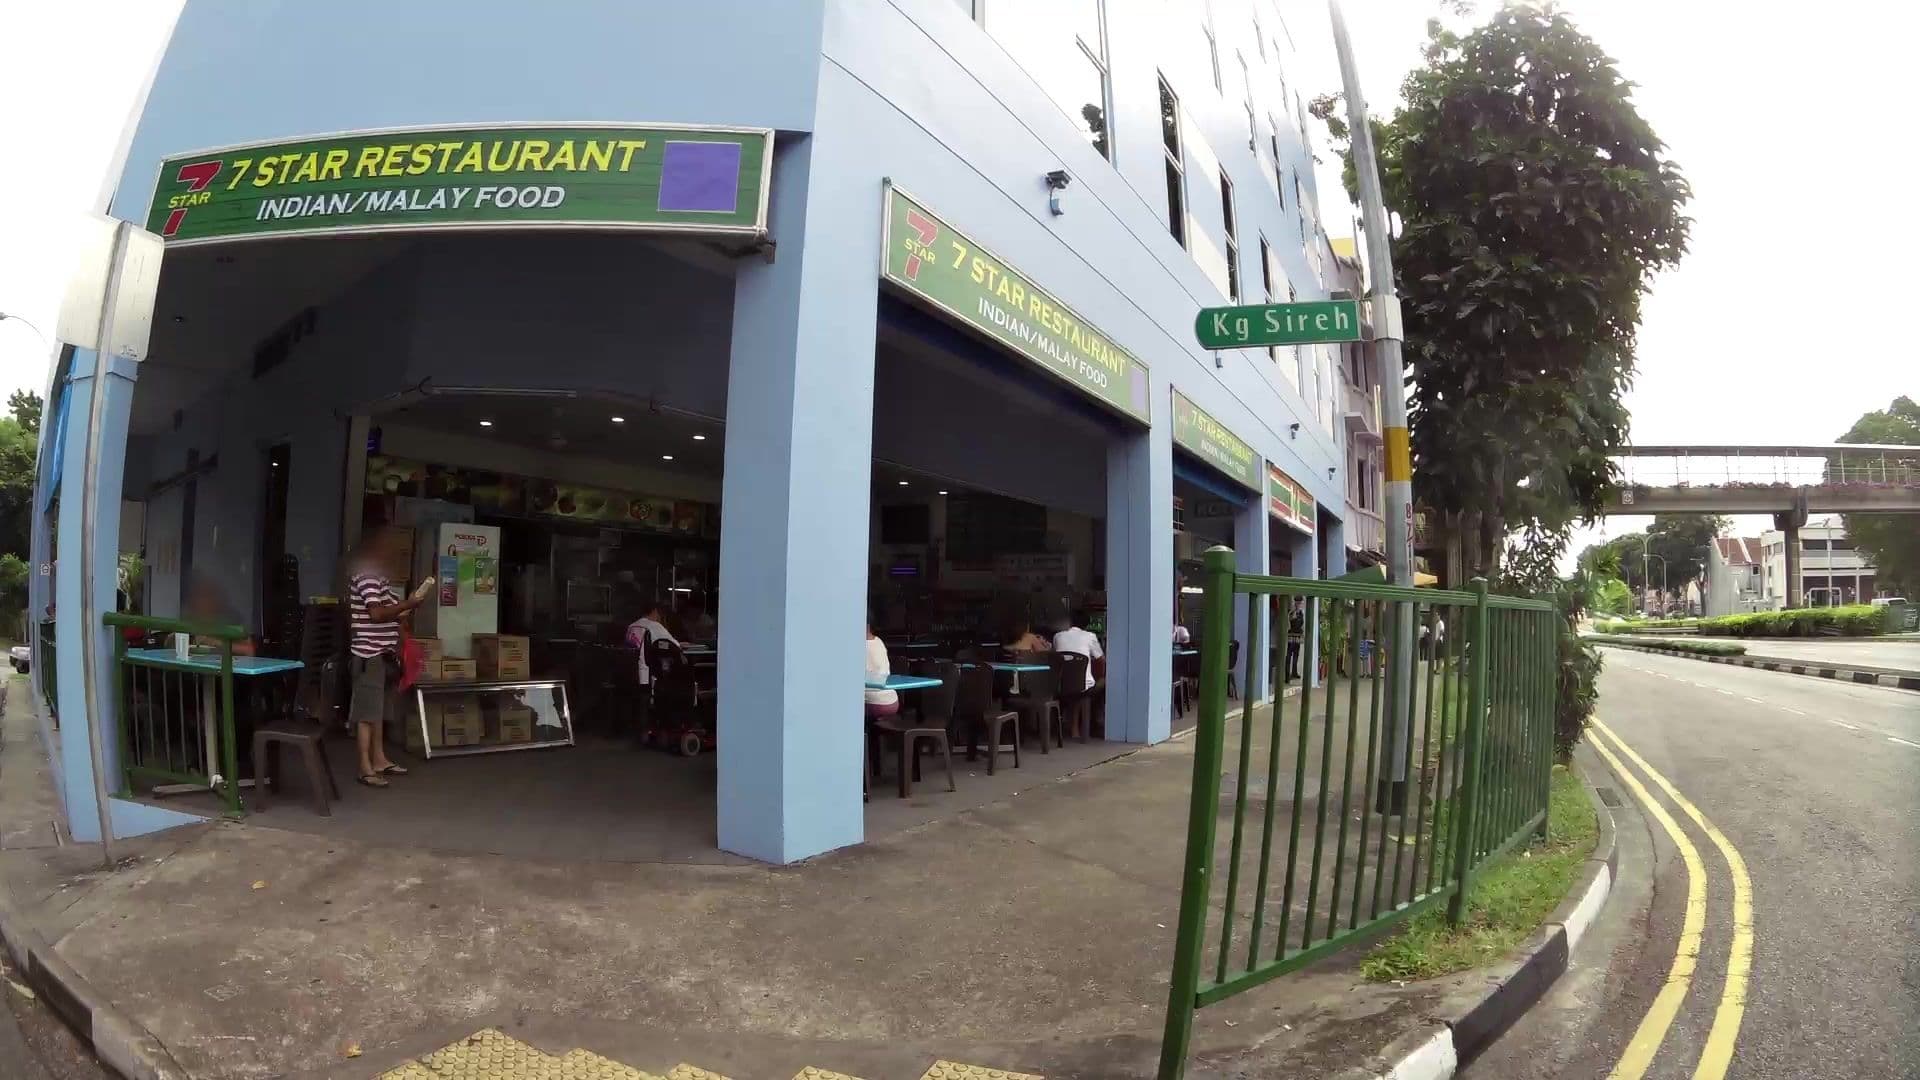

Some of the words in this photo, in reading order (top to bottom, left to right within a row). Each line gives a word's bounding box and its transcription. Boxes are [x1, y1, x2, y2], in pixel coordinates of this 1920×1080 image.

[226, 160, 249, 190] 7
[253, 150, 348, 188] STAR
[352, 139, 646, 180] RESTAURANT
[168, 189, 212, 209] STAR
[255, 186, 473, 221] INDIAN/MALAY
[477, 185, 566, 210] FOOD
[904, 238, 936, 265] STAR
[952, 241, 967, 269] 7
[971, 256, 1025, 311] STAR
[1028, 293, 1127, 377] RESTAURANT
[1213, 312, 1249, 341] Kg
[1265, 306, 1348, 333] Sireh
[978, 297, 1079, 374] INDIAN/MALAY
[1079, 360, 1108, 388] FOOD
